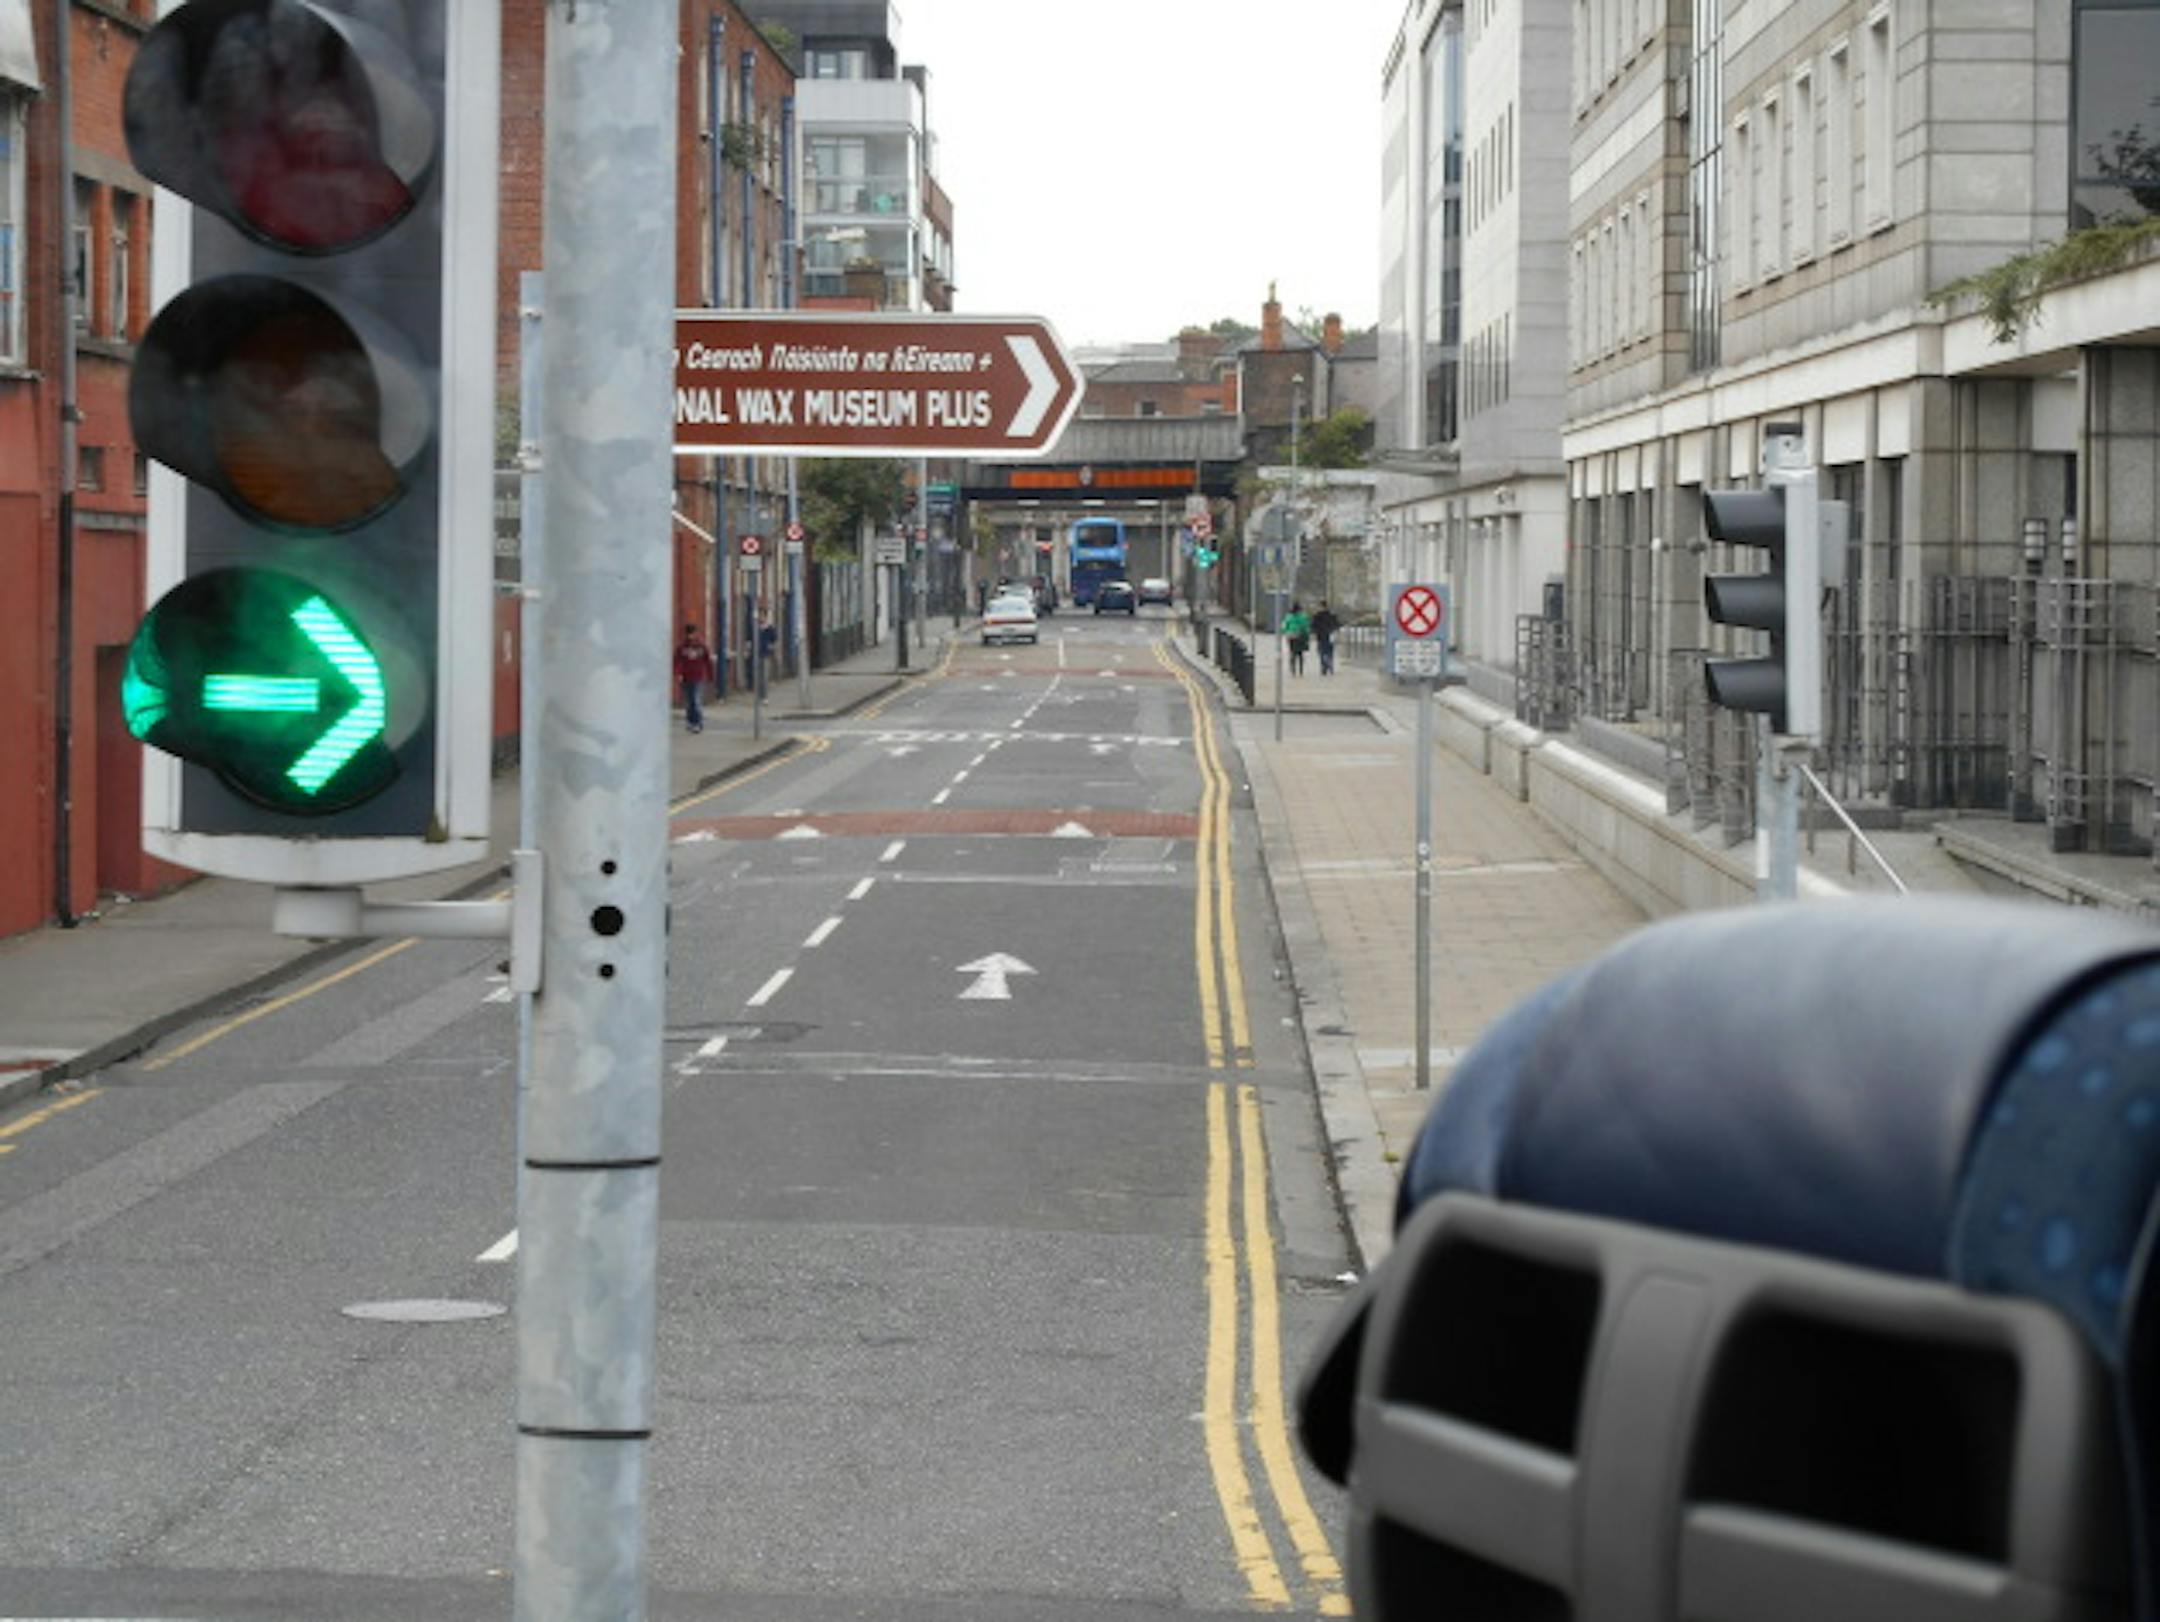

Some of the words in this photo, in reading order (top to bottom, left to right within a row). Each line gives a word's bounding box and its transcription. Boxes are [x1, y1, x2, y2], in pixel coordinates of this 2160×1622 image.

[862, 352, 888, 372] na
[671, 387, 730, 424] NAL
[735, 388, 794, 424] WAX
[804, 389, 917, 427] MUSEUM
[927, 390, 992, 427] PLUS
